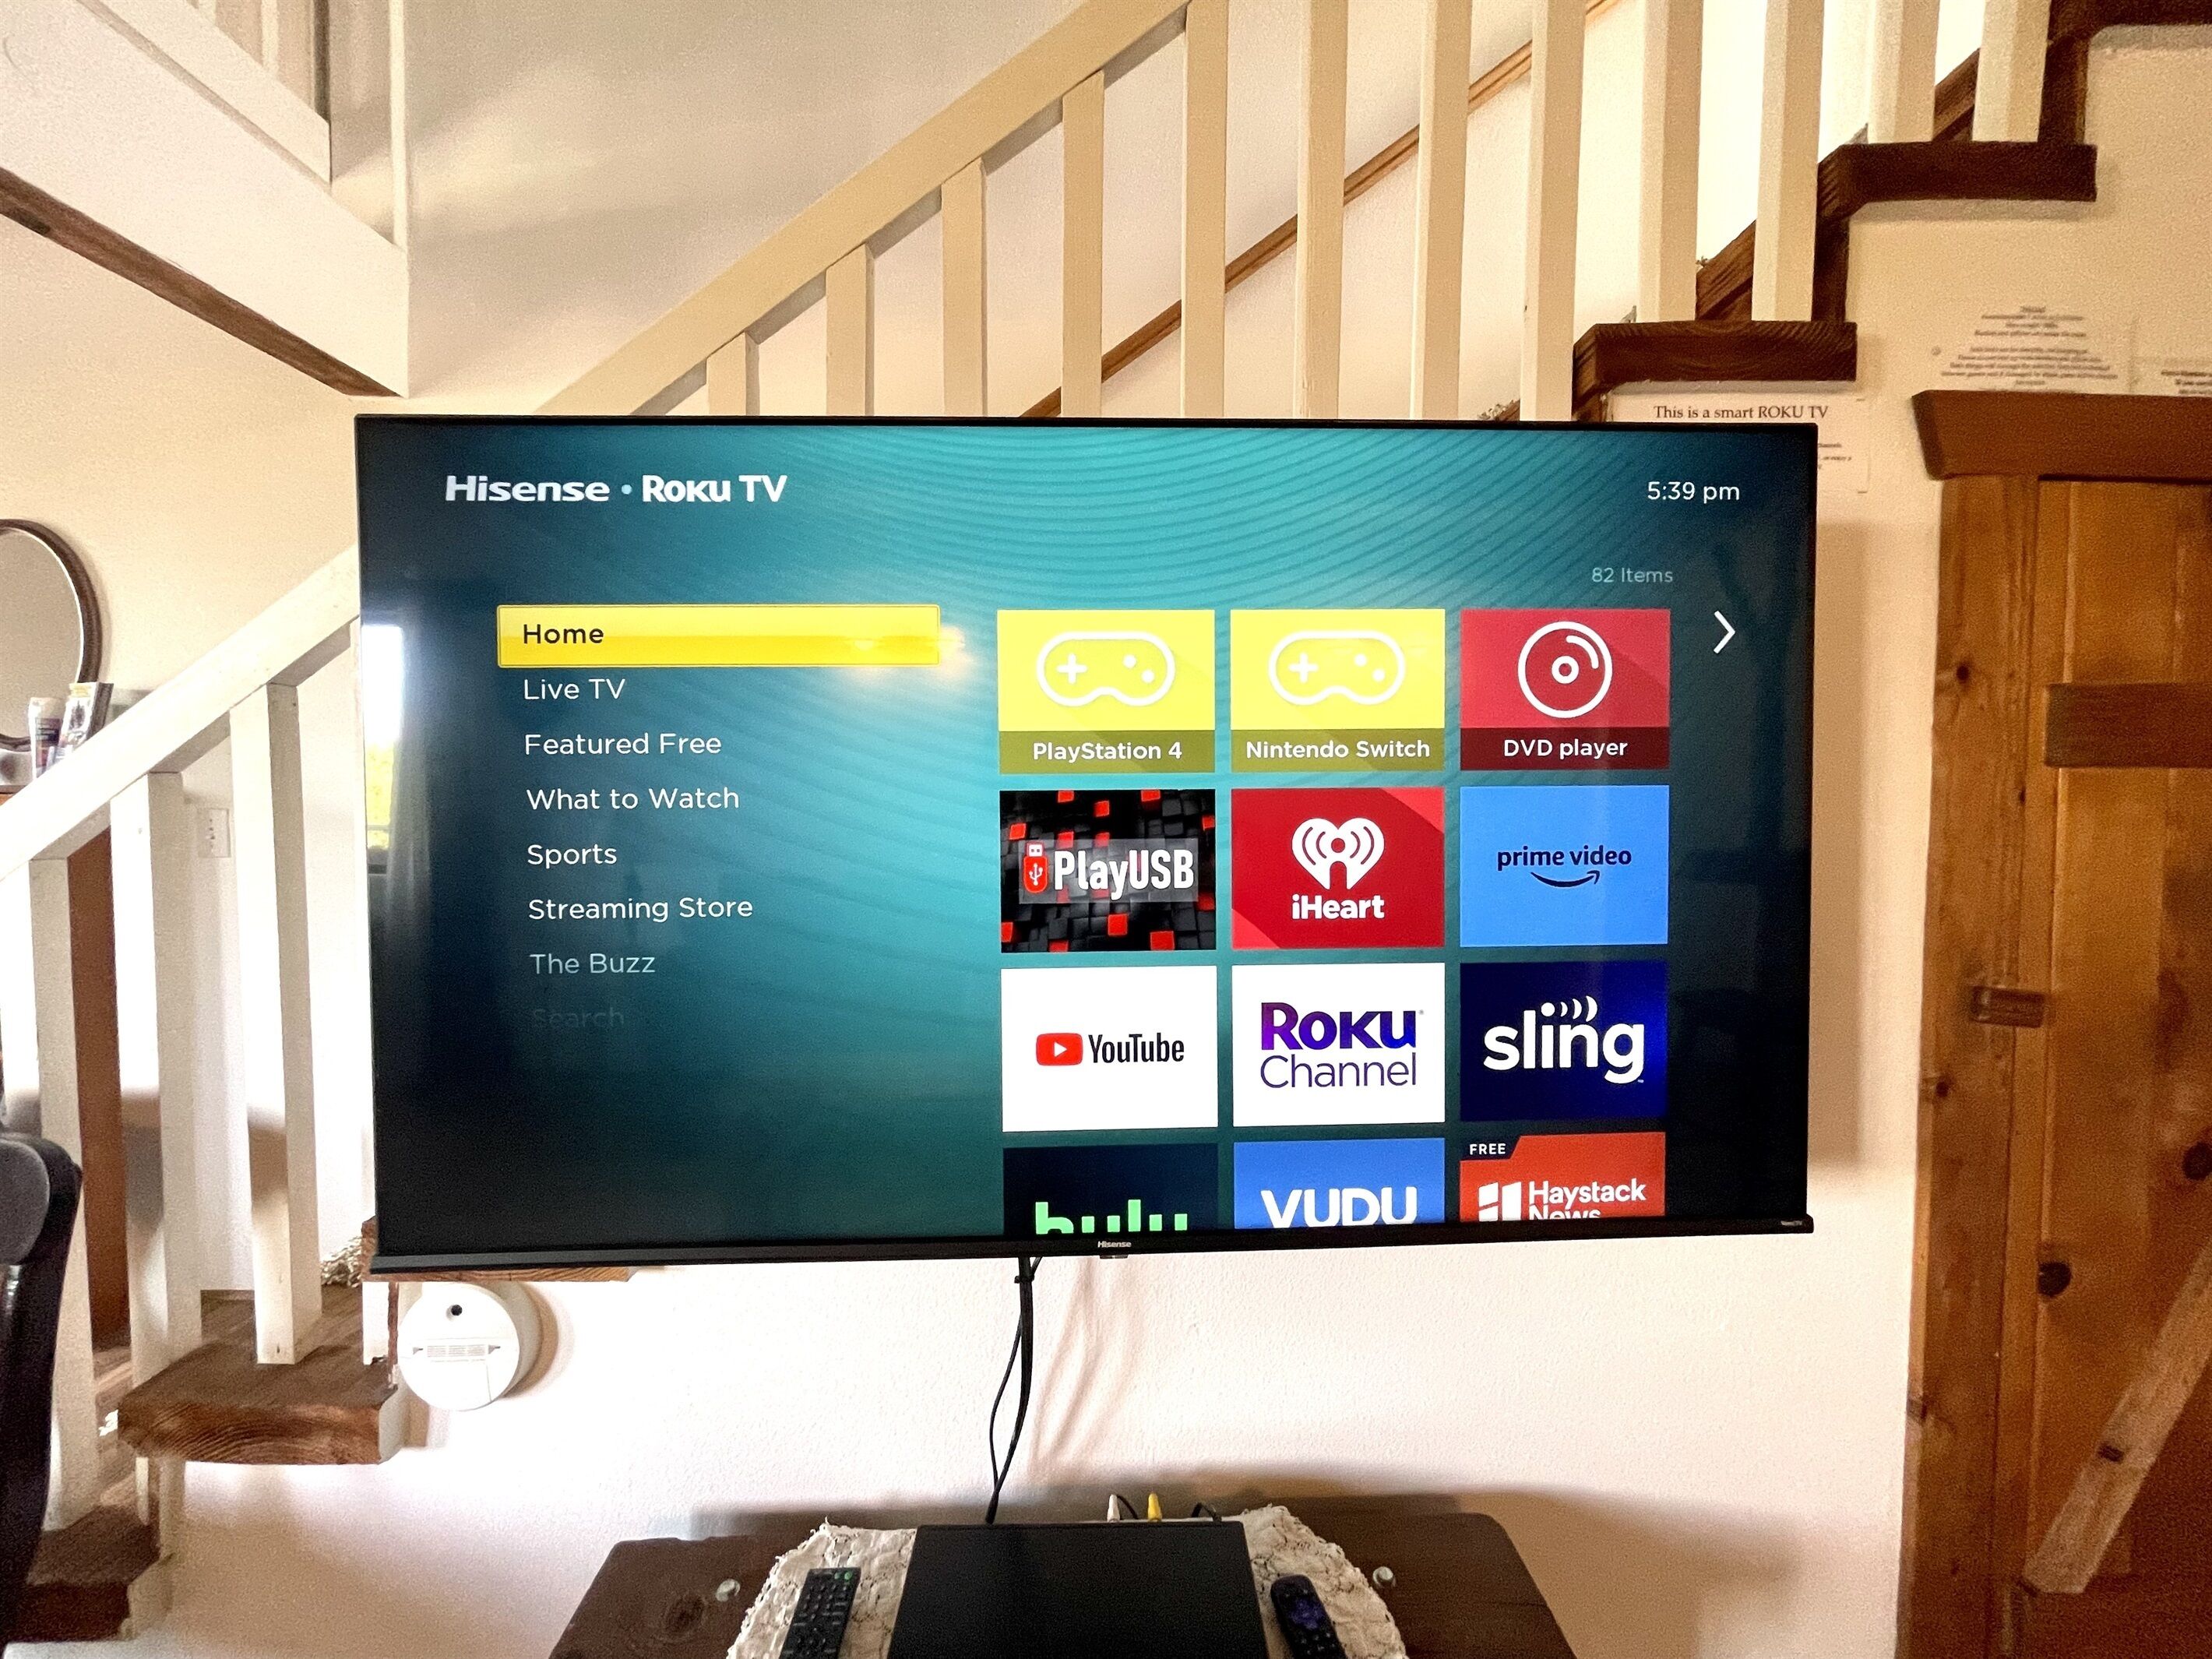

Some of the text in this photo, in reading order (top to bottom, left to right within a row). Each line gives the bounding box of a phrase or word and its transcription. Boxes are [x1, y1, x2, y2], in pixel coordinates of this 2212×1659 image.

[1654, 405, 1830, 420] This is a smart ROKU TV
[446, 474, 610, 502] Hisense
[738, 474, 788, 502] TV
[1647, 481, 1740, 504] 5:39 pm
[1591, 567, 1674, 583] 82 Items
[523, 624, 604, 644] Home
[523, 678, 625, 700] Live TV
[524, 732, 722, 756] Featured Free
[1032, 740, 1183, 763] PlayStation 4
[1246, 738, 1431, 760] Nintendo Switch
[1504, 738, 1629, 760] DVD player
[527, 787, 740, 810] What to Watch
[527, 844, 618, 869] Sports
[1497, 844, 1633, 872] prime video
[1054, 848, 1195, 901] PlayUSB
[528, 896, 753, 923] Streaming Store
[1291, 894, 1386, 921] iHeart
[530, 953, 656, 974] The Buzz
[1088, 1032, 1185, 1065] YouTube
[1483, 1002, 1645, 1084] sling
[1260, 1052, 1418, 1088] Channel
[1469, 1143, 1506, 1156] FREE
[1529, 1178, 1647, 1207] Haystack
[1260, 1185, 1418, 1229] VUDU
[1529, 1204, 1601, 1220] News
[1097, 1240, 1132, 1249] Hisense
